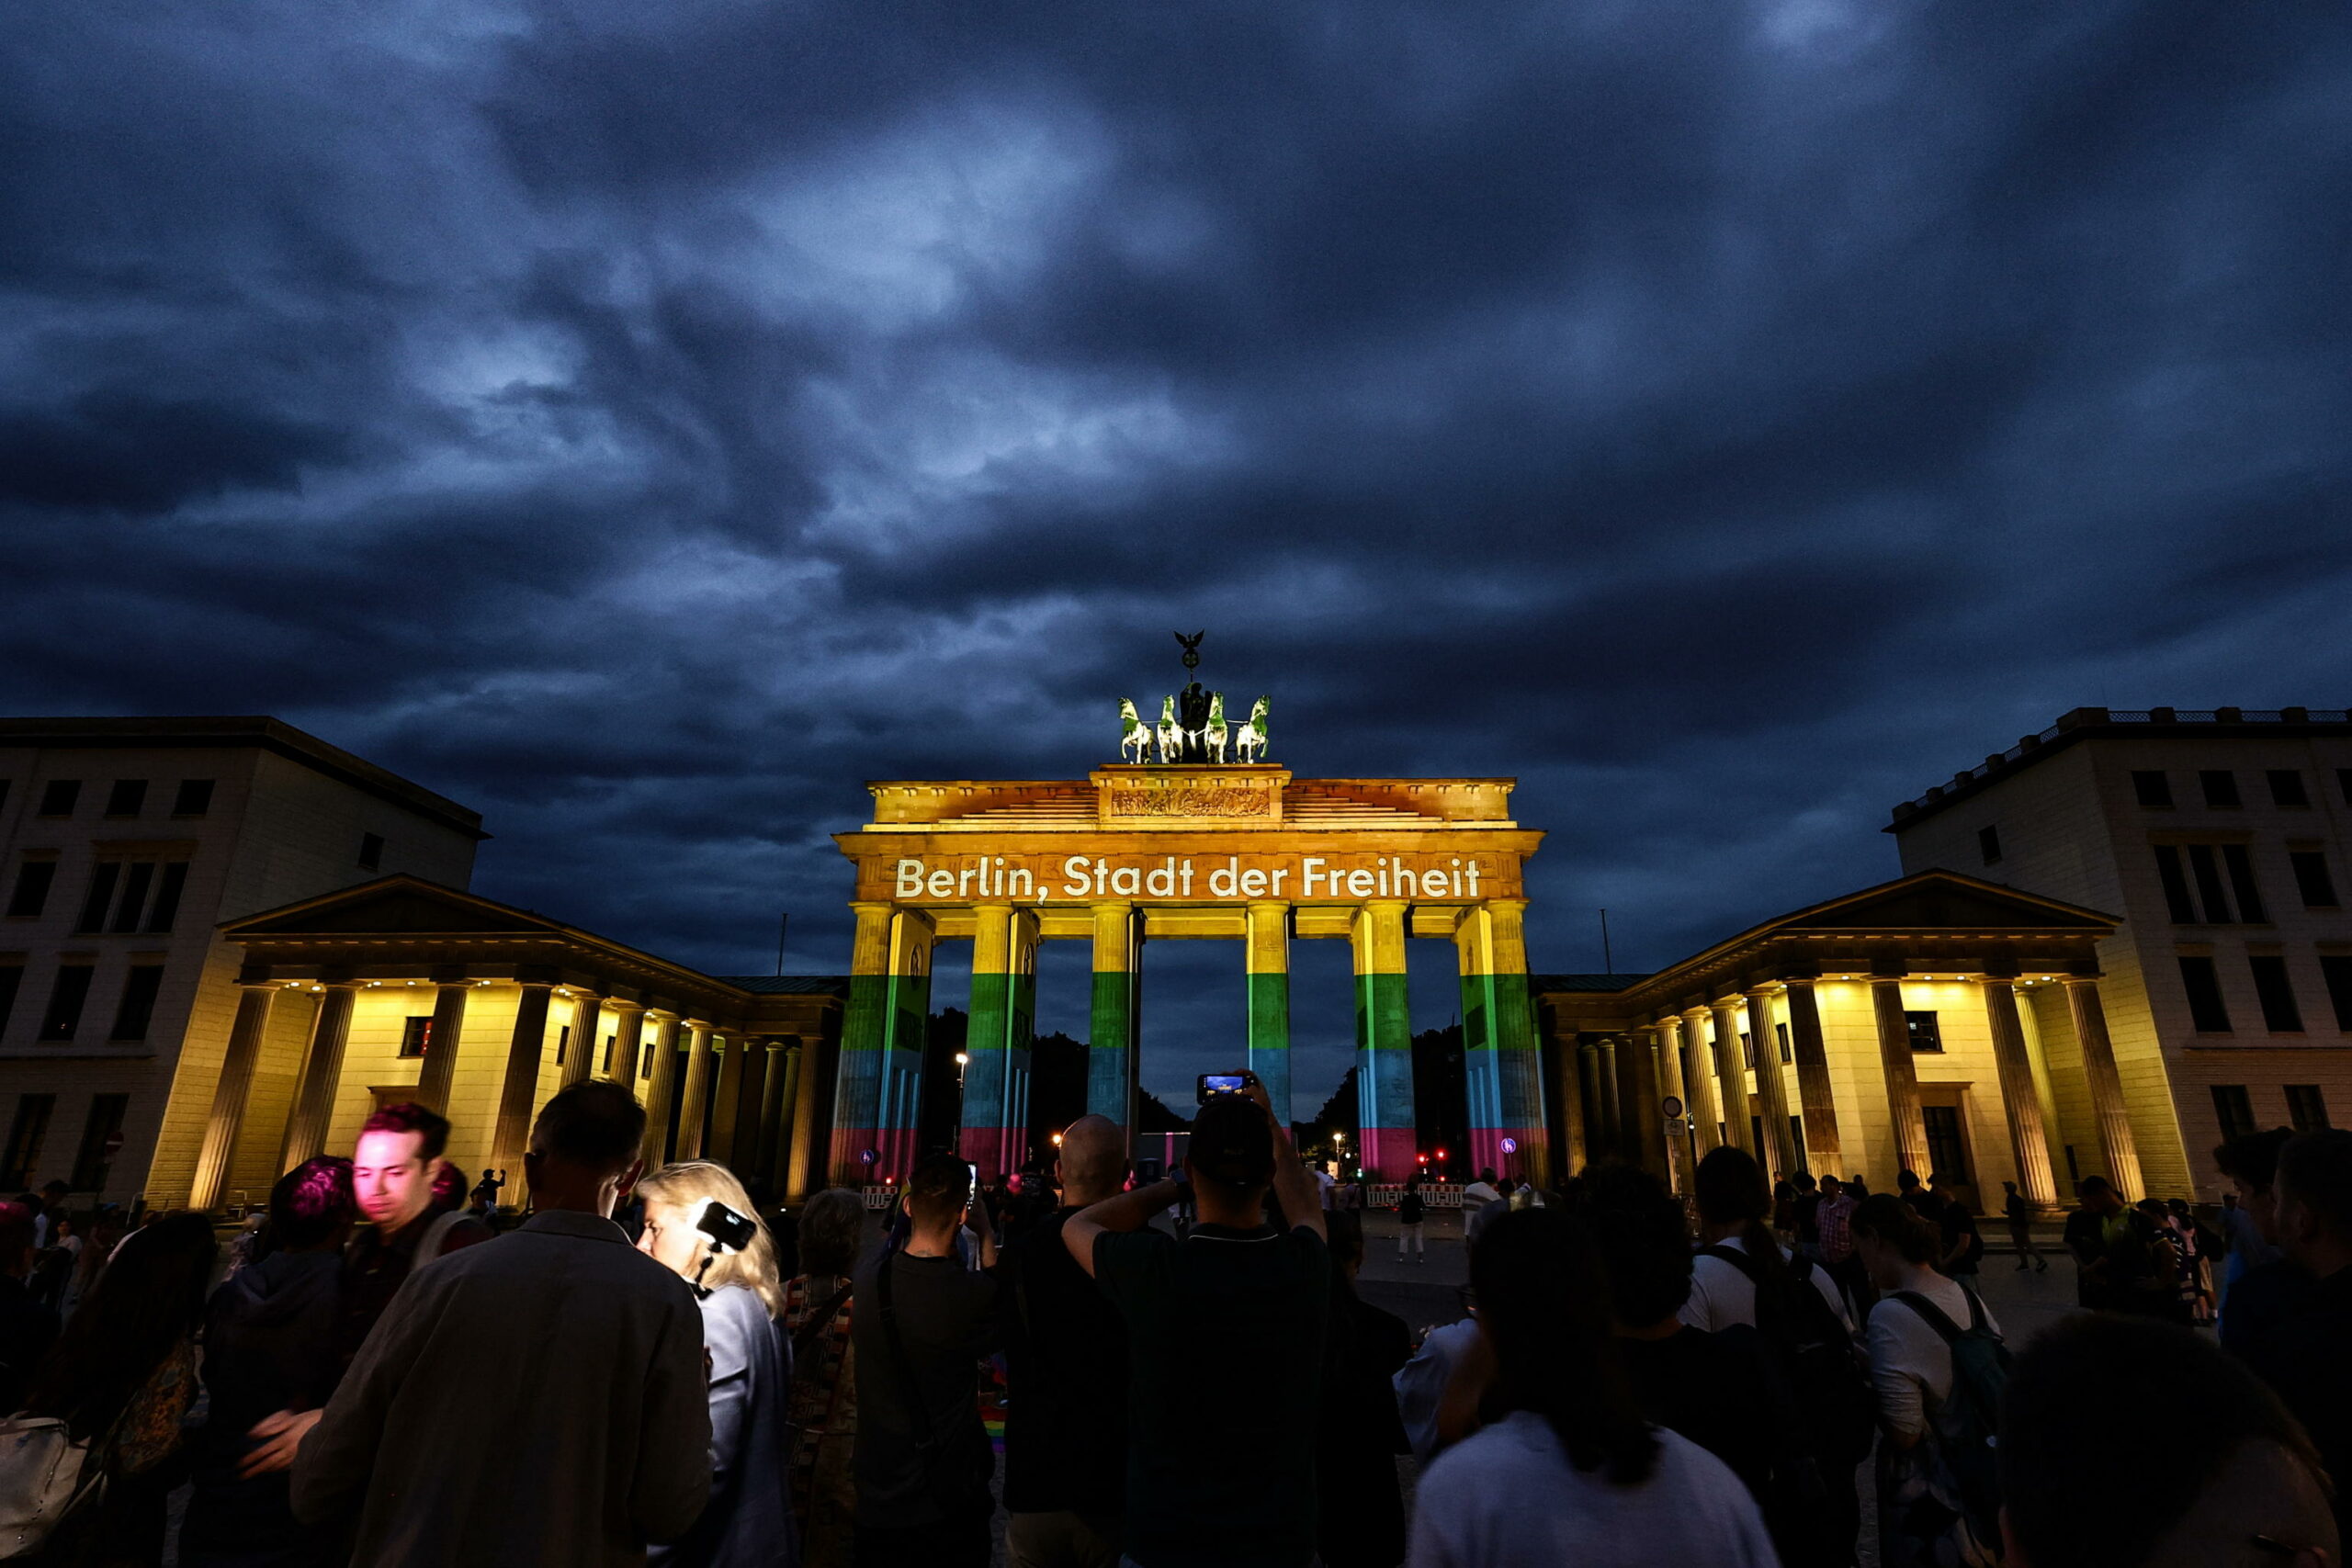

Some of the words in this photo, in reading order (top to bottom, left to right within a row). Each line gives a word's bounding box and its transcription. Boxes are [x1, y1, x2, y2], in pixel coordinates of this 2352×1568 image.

[895, 856, 1048, 905] Berlin,
[1062, 855, 1194, 897] Stadt
[1208, 855, 1288, 897] der
[1302, 856, 1480, 897] Freiheit
